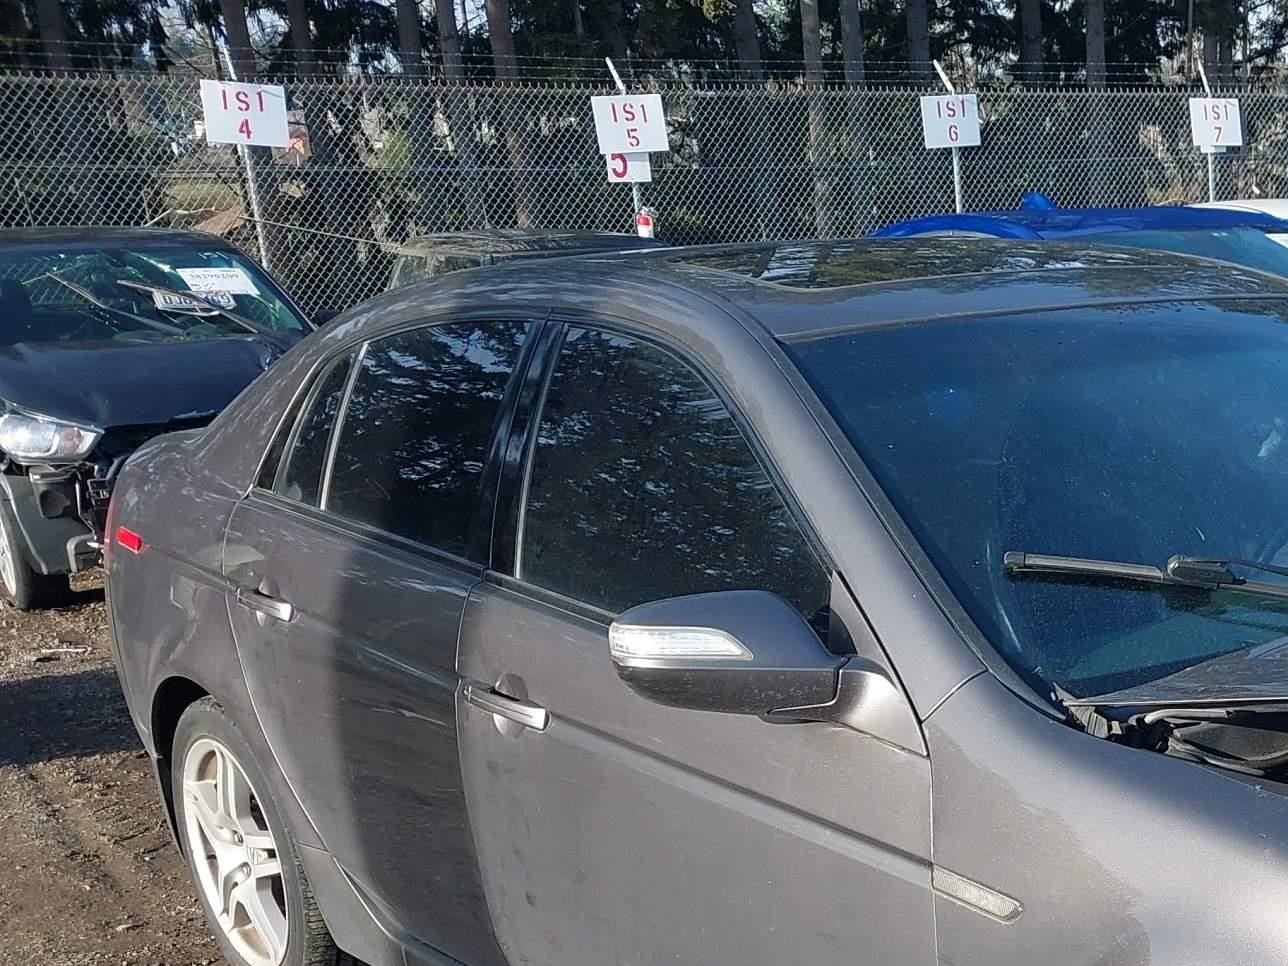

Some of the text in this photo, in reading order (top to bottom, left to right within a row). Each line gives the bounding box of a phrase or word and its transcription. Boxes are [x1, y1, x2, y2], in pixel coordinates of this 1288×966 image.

[239, 118, 252, 139] 4
[626, 128, 640, 147] 5
[948, 124, 959, 142] 6
[1214, 126, 1222, 142] 7
